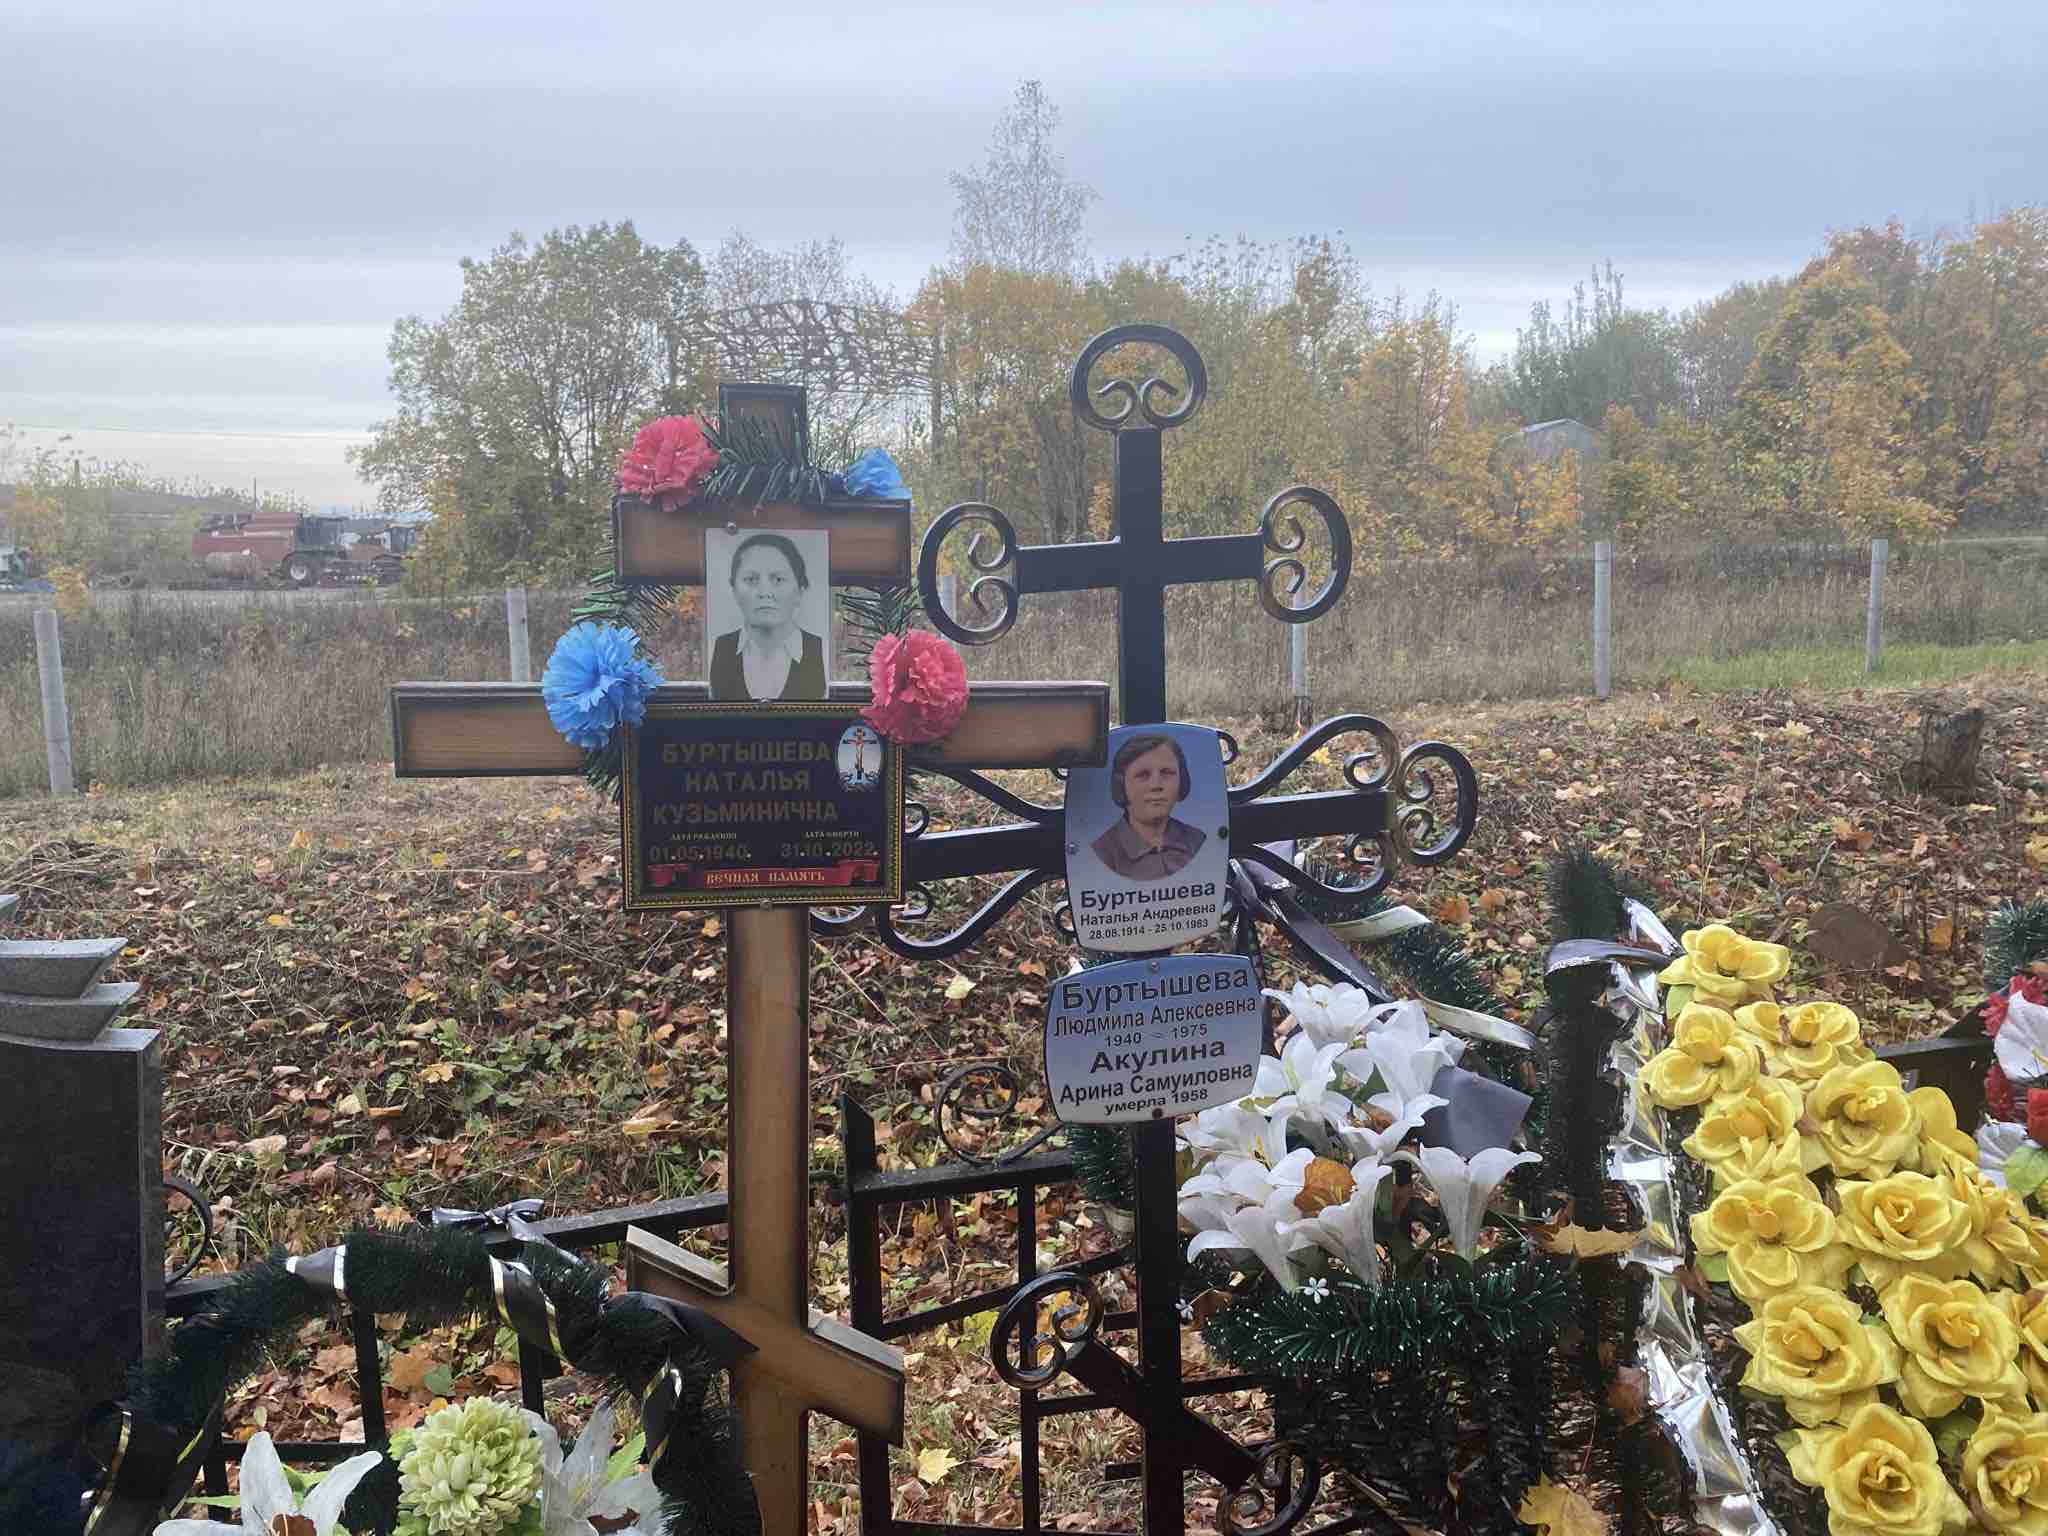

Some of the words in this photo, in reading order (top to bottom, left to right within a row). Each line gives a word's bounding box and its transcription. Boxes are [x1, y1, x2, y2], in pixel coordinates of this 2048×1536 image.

[663, 740, 833, 764] БУРТЫШЕВА
[685, 770, 810, 793] НАТАЛЬЯ
[653, 801, 839, 825] КУЗЬМИНИЧНА
[1080, 882, 1216, 911] Буртышева
[1080, 911, 1138, 927] Наталья
[1142, 902, 1216, 921] Андреевна
[1062, 969, 1249, 1013] Буртышева
[1054, 1011, 1144, 1037] Людмила
[1150, 998, 1257, 1025] Алексеевна
[1105, 1032, 1142, 1047] 1940
[1171, 1023, 1208, 1040] 1975
[1090, 1040, 1226, 1074] Акулина
[1059, 1083, 1124, 1107] Арина
[1129, 1063, 1253, 1096] Самуиловна
[1104, 1096, 1166, 1116] умерла
[1171, 1088, 1209, 1104] 1958
